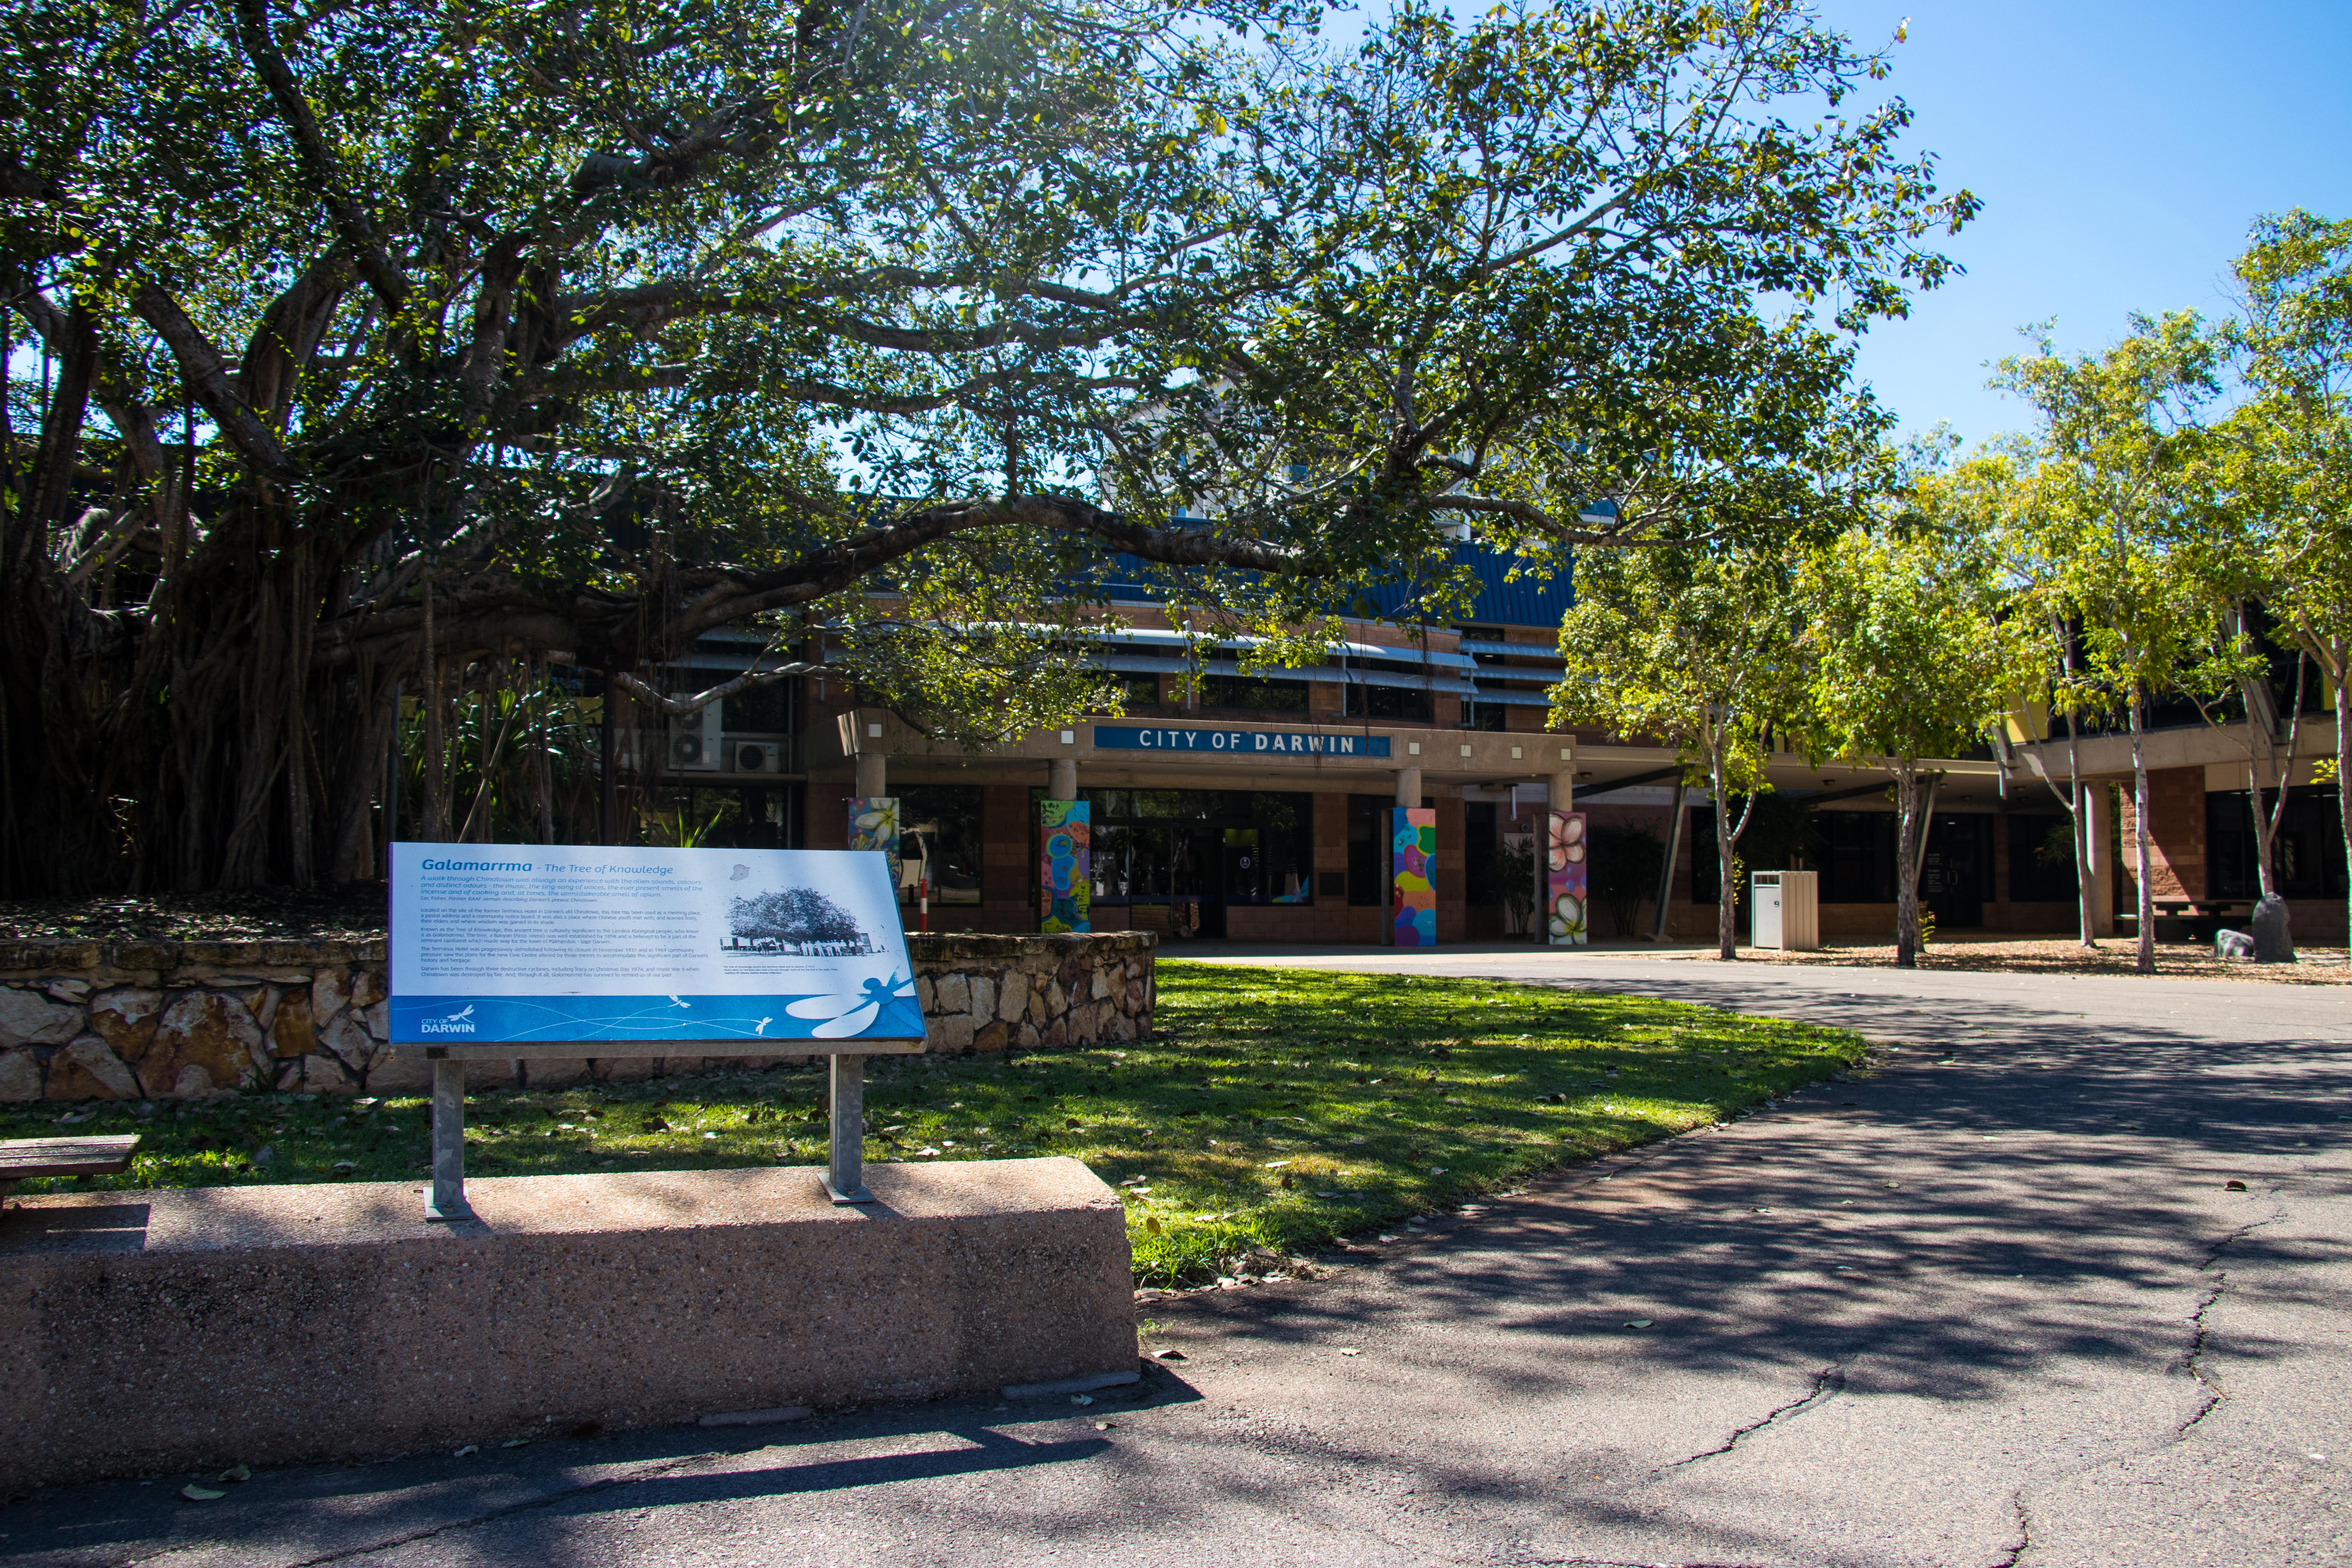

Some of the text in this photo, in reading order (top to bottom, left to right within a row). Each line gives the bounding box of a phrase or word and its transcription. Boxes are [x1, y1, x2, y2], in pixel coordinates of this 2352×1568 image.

[1139, 730, 1353, 753] CITY OF DARWIN
[422, 859, 532, 871] Galamarrma
[545, 864, 565, 872] The
[569, 864, 592, 873] Tree
[595, 865, 607, 875] of
[609, 865, 673, 876] Knowledge
[421, 1024, 475, 1033] DARWIN
